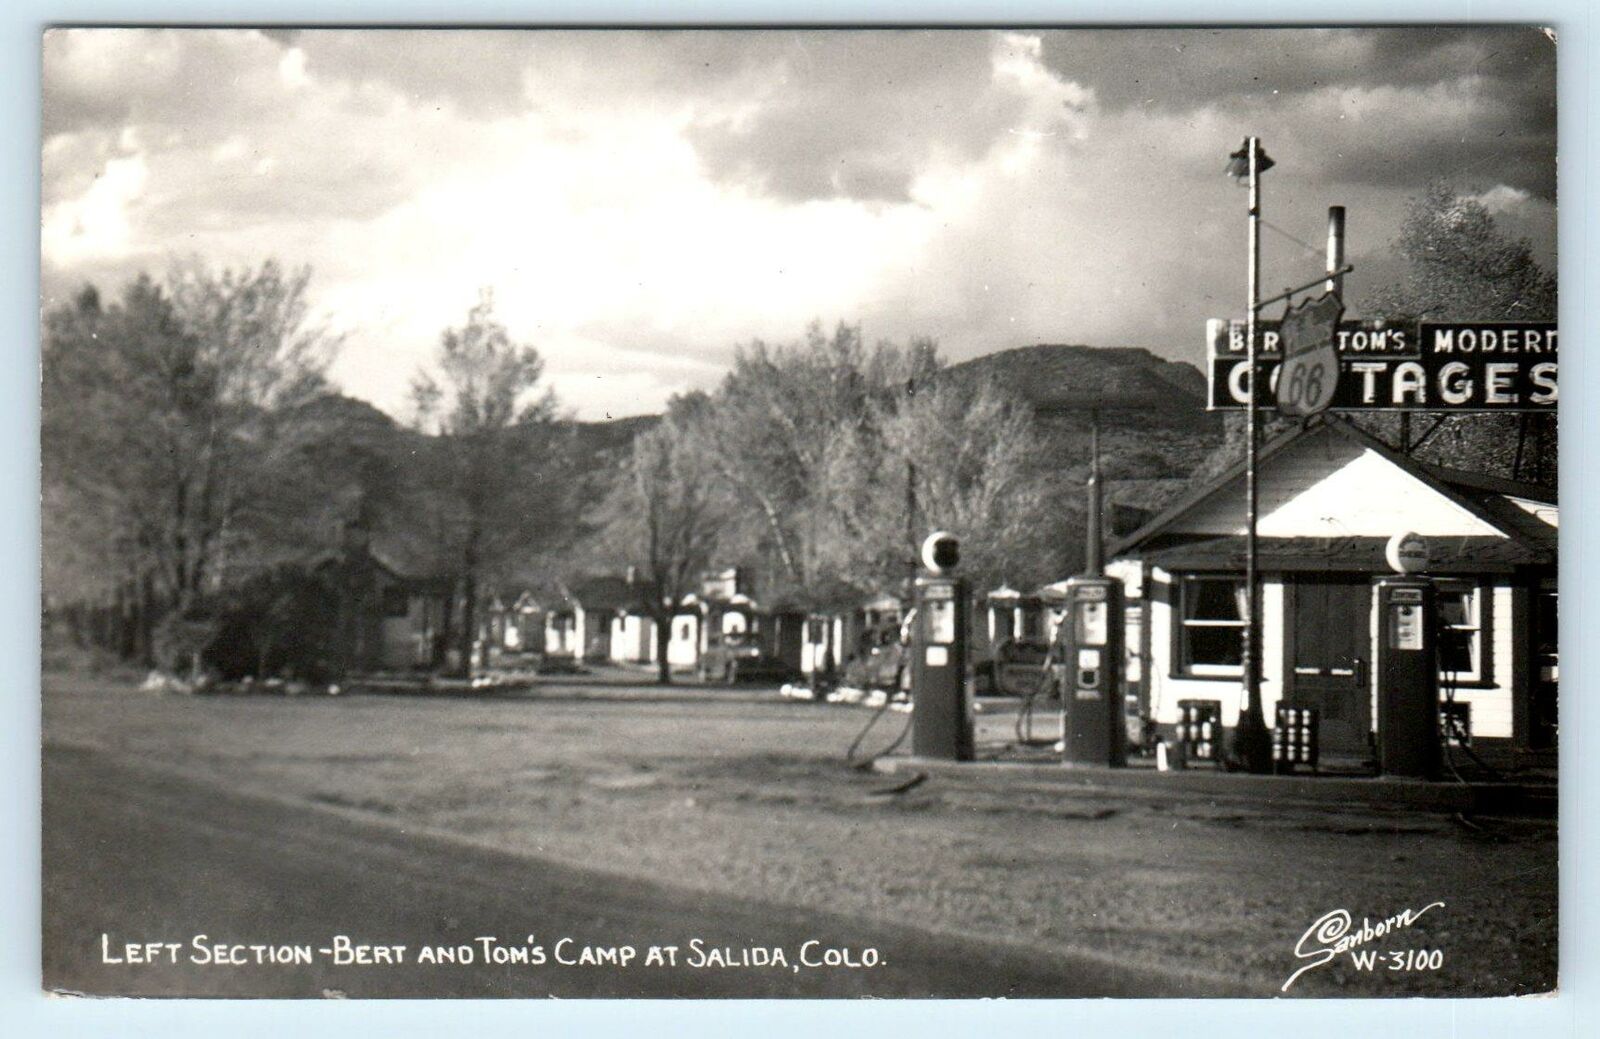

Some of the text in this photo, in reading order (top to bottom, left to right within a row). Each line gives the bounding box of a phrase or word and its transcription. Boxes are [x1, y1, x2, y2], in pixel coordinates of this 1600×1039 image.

[1337, 329, 1406, 351] TOM'S
[1227, 360, 1558, 405] CTAGES
[1288, 362, 1325, 407] 66
